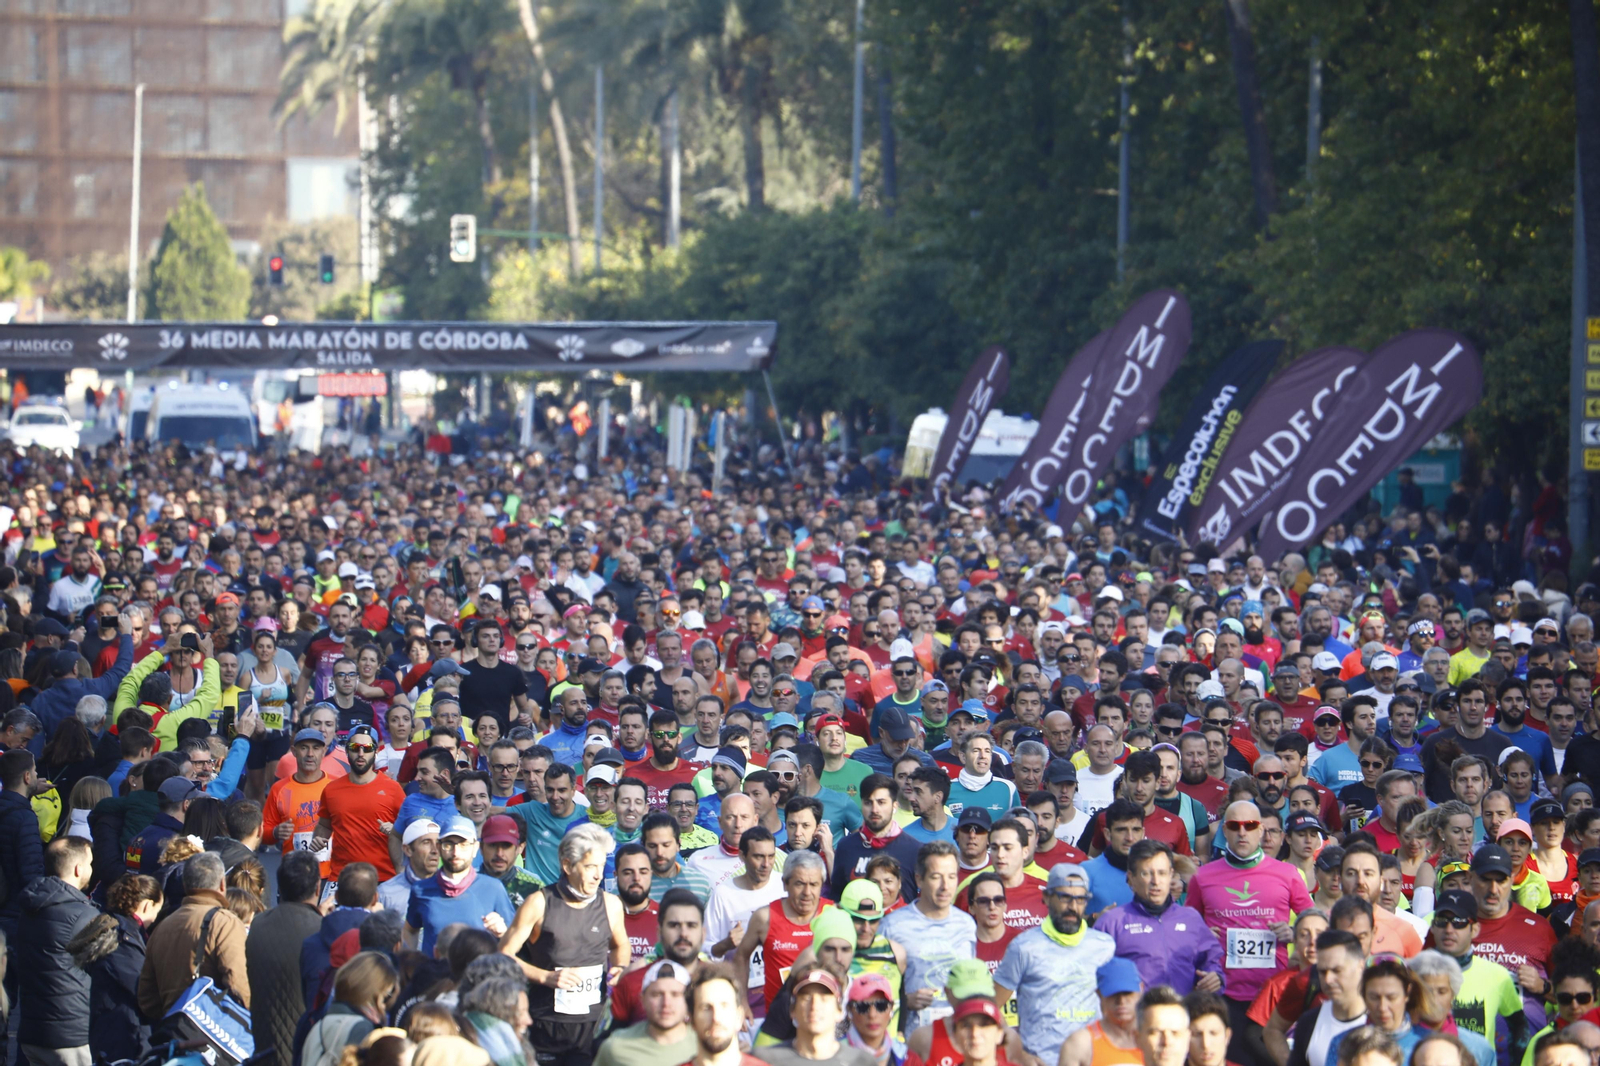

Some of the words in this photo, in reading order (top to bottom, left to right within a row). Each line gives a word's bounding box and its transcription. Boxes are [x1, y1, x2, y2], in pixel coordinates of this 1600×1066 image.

[13, 339, 73, 351] IMDECO
[158, 330, 185, 349] 36
[191, 330, 260, 349] MEDIA
[268, 328, 378, 349] MARATÓN
[385, 332, 412, 348] DE
[418, 327, 529, 350] CÓRDOBA
[317, 351, 373, 366] SALIDA
[1065, 296, 1176, 505] IMDECO
[1276, 341, 1464, 542] IMDECO
[1189, 408, 1243, 507] exclusive
[1003, 909, 1032, 919] MEDIA
[1214, 906, 1275, 919] Extremadura
[1004, 914, 1047, 928] MARATÓN
[1237, 940, 1275, 955] 3217
[1471, 943, 1504, 953] MEDIA
